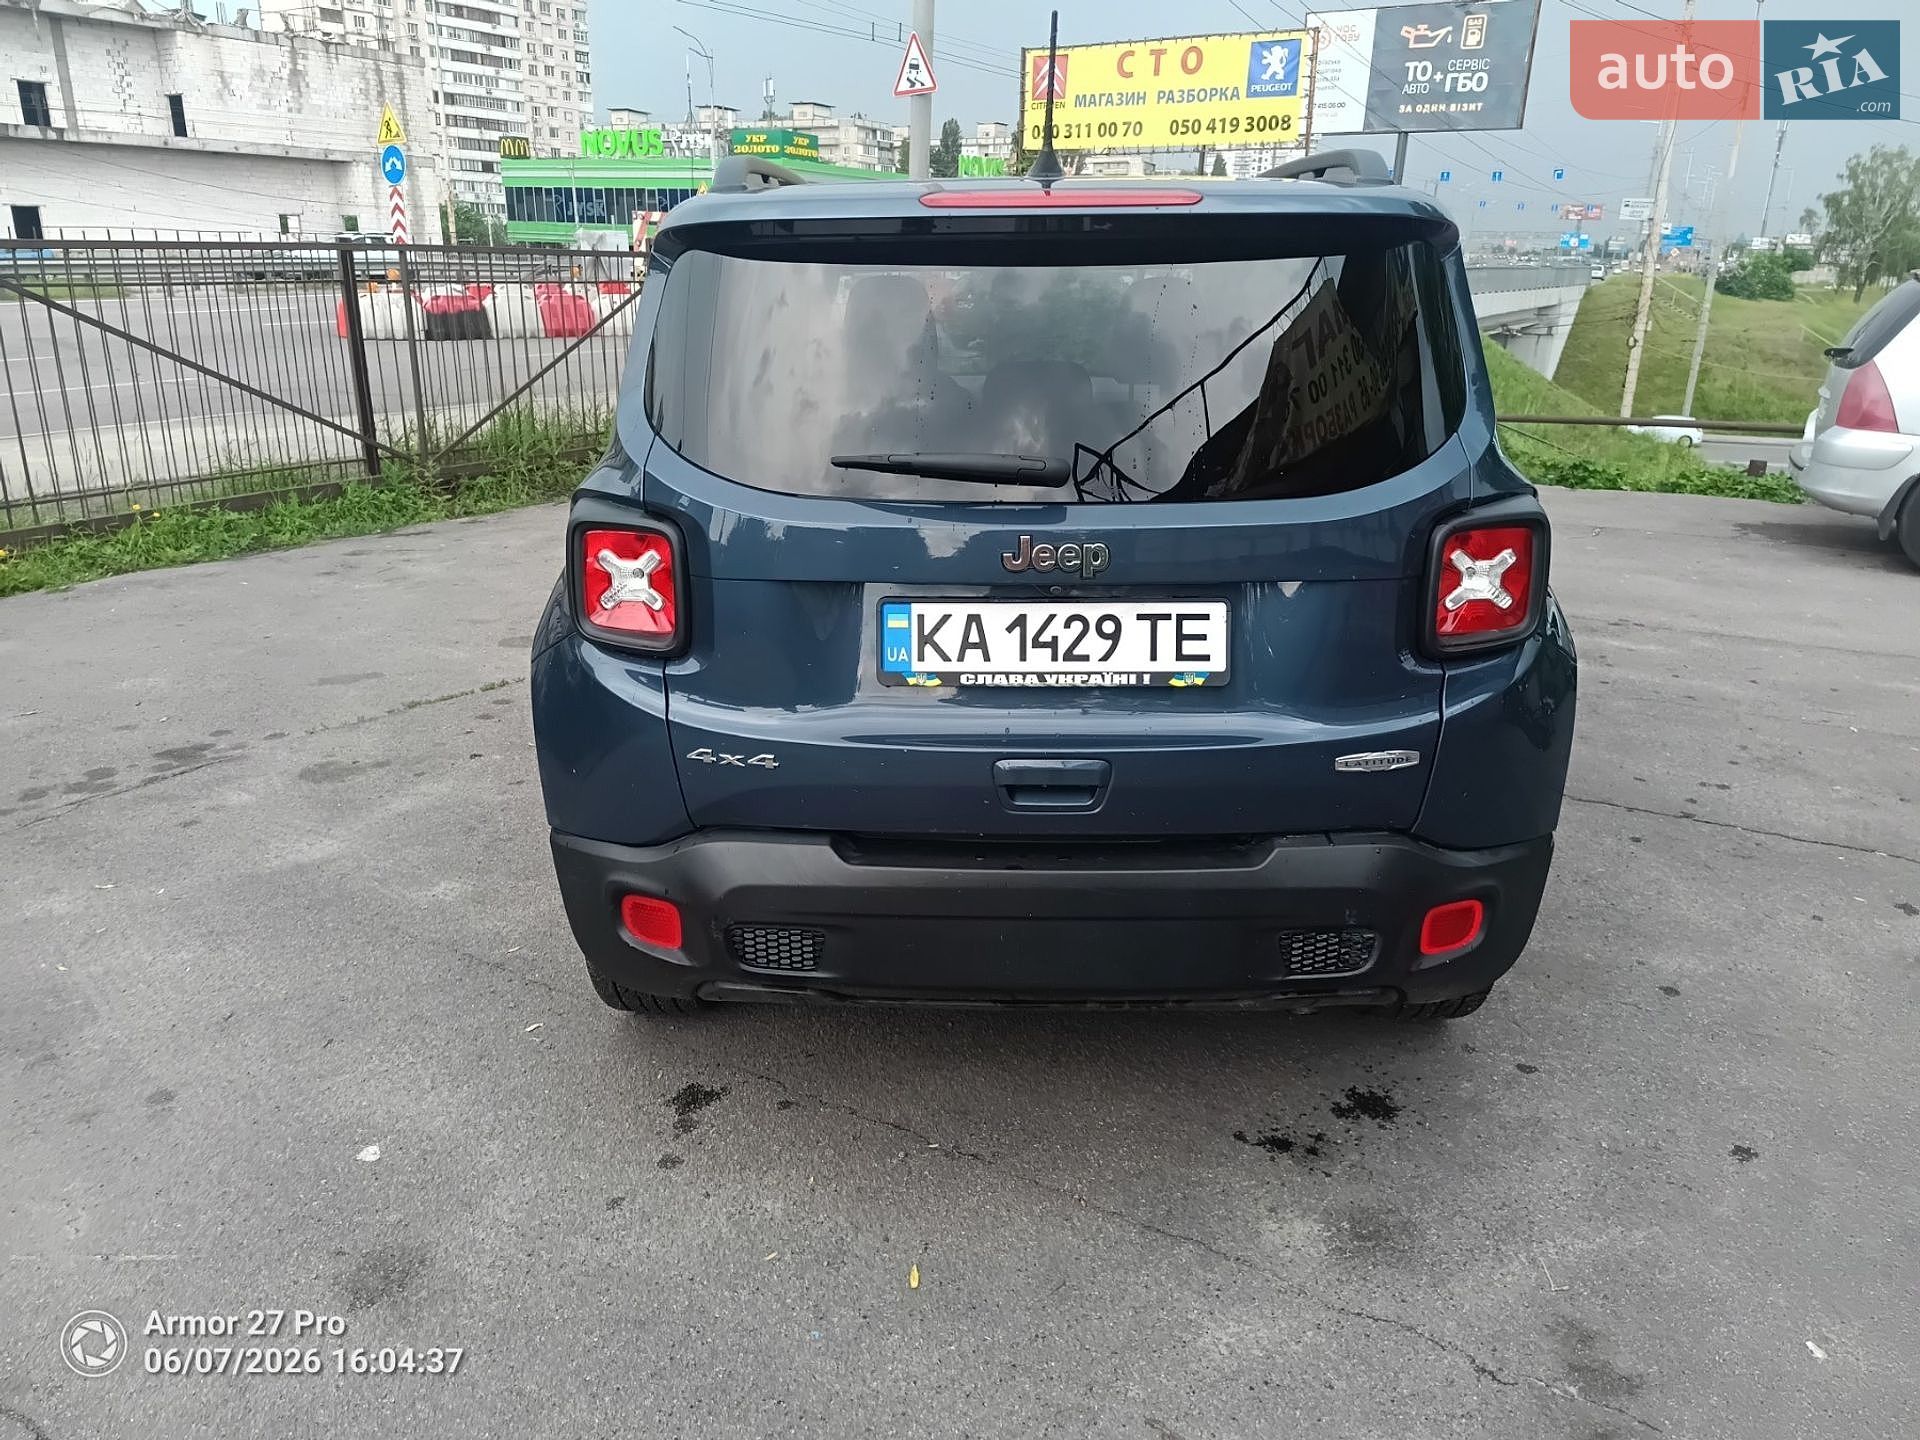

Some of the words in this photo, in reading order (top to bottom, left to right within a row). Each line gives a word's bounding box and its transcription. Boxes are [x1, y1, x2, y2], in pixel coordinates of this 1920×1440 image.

[1117, 46, 1204, 78] СТО
[1447, 58, 1491, 71] СЕРВІС
[1405, 60, 1432, 82] ТО
[1444, 71, 1489, 93] ГБО
[1250, 82, 1293, 93] PEUGEOT
[1401, 83, 1430, 95] АВТО
[1074, 91, 1147, 108] МАГАЗИН
[1156, 86, 1241, 105] РАЗБОРКА
[1399, 104, 1413, 113] ЗА
[1063, 123, 1092, 139] 311
[1097, 122, 1118, 138] 00
[1122, 120, 1143, 137] 70
[1169, 118, 1202, 136] 050
[1206, 117, 1240, 135] 419
[1244, 114, 1292, 133] 3008
[580, 128, 664, 157] NOVUS
[745, 133, 768, 143] УКР
[793, 136, 809, 146] УКР
[733, 144, 780, 154] ЗОЛОТО
[784, 145, 818, 158] ЗОЛОТО
[1001, 534, 1112, 580] Jeep
[916, 613, 991, 663] KA
[1004, 613, 1123, 663] 1429
[1136, 612, 1211, 663] TE
[887, 647, 909, 662] UA
[959, 672, 1041, 687] СЛАВА
[1042, 671, 1137, 687] УКРАЇНІ
